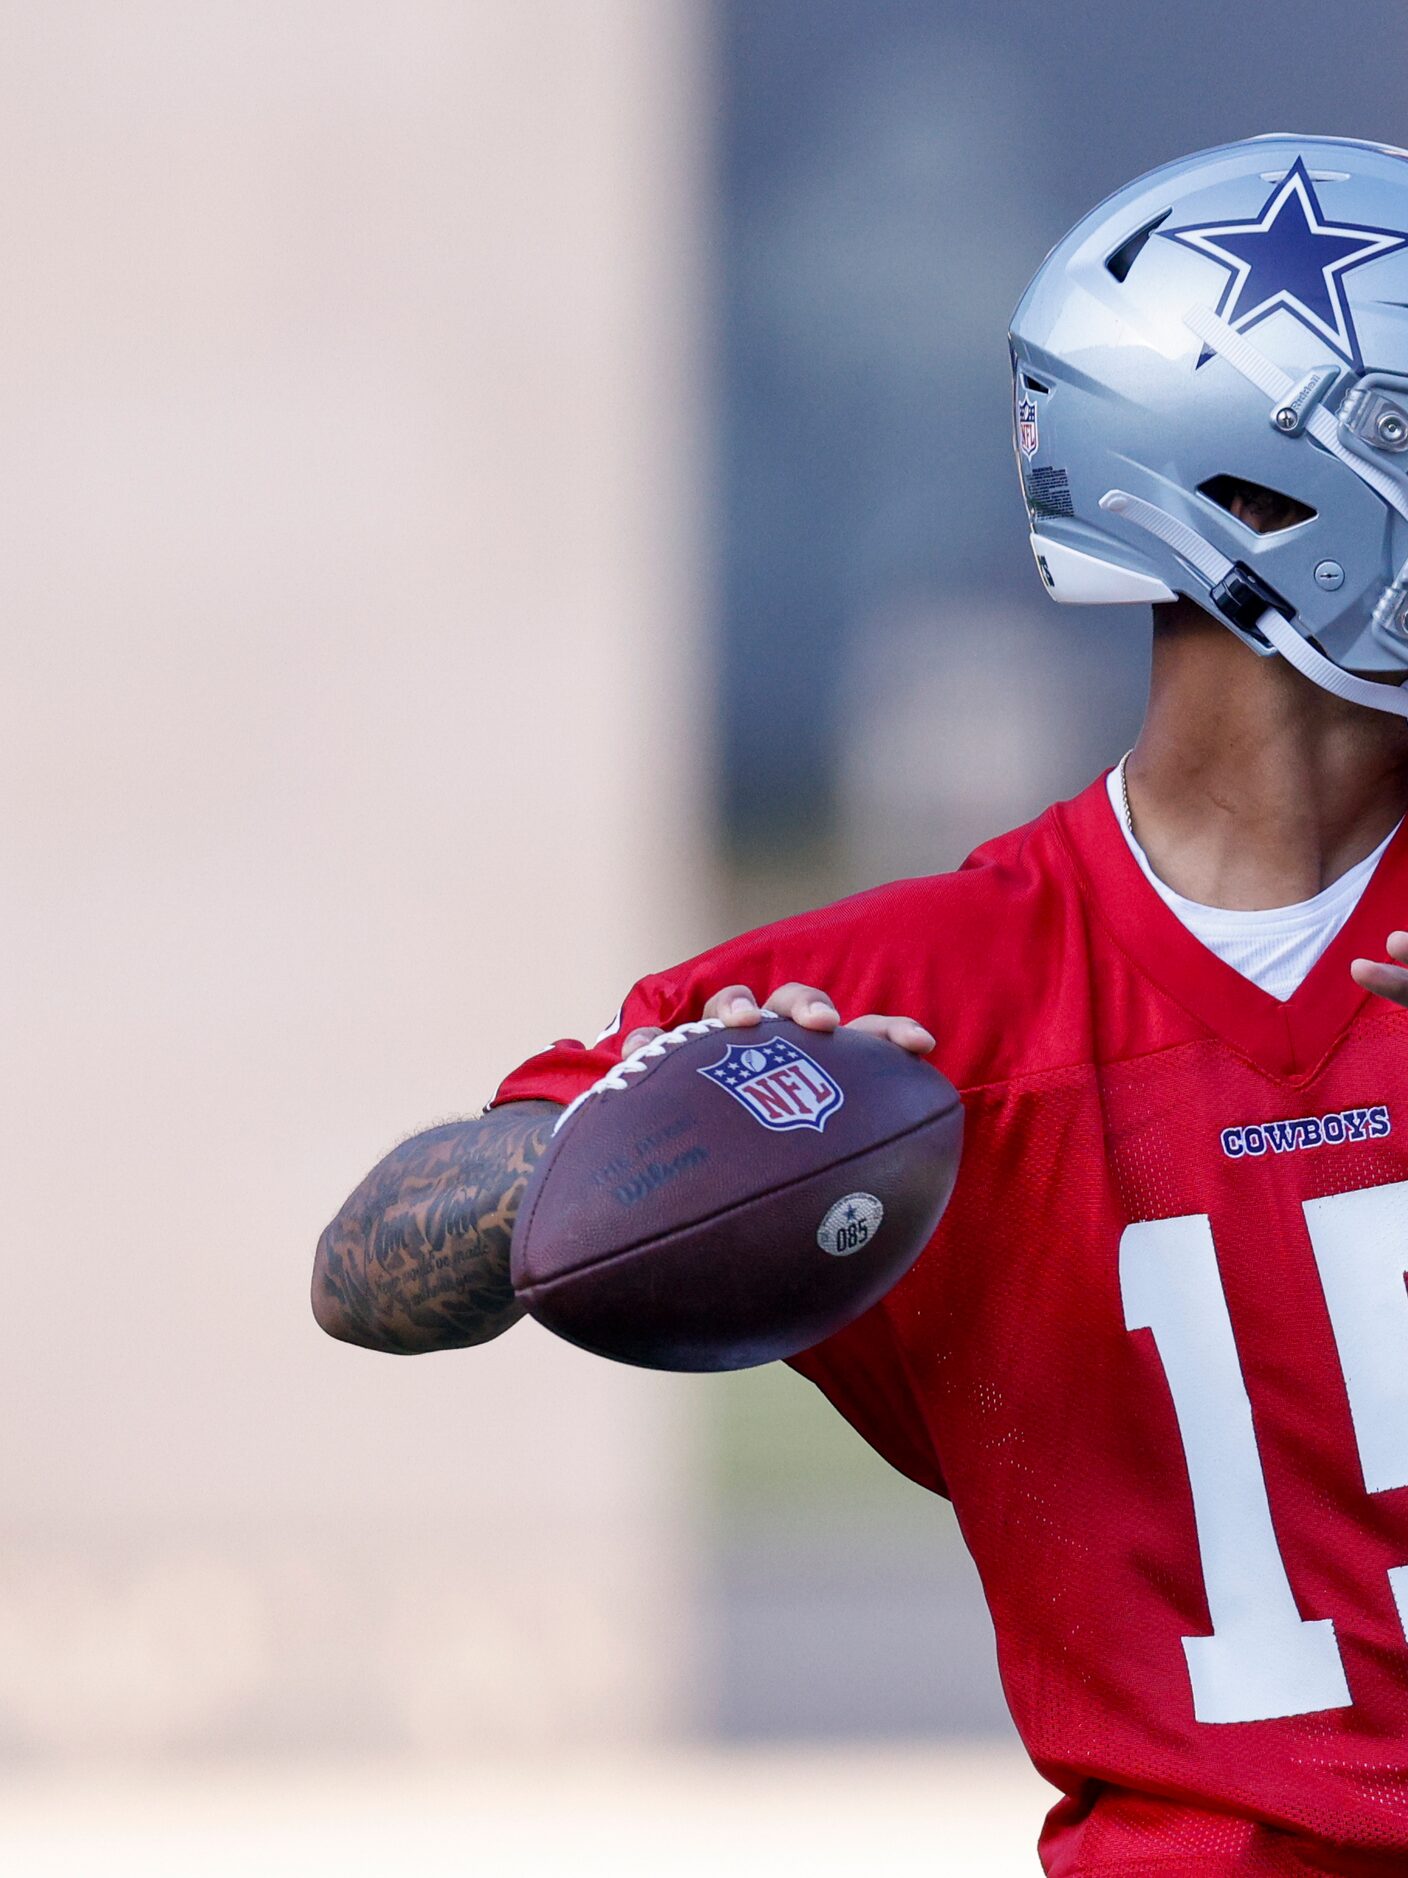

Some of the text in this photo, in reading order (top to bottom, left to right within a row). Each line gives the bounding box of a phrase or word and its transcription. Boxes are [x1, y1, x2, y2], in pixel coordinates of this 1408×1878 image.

[1021, 423, 1036, 451] NFL
[741, 1065, 833, 1119] NFL
[1221, 1105, 1392, 1158] COWBOYS
[837, 1217, 868, 1252] 085
